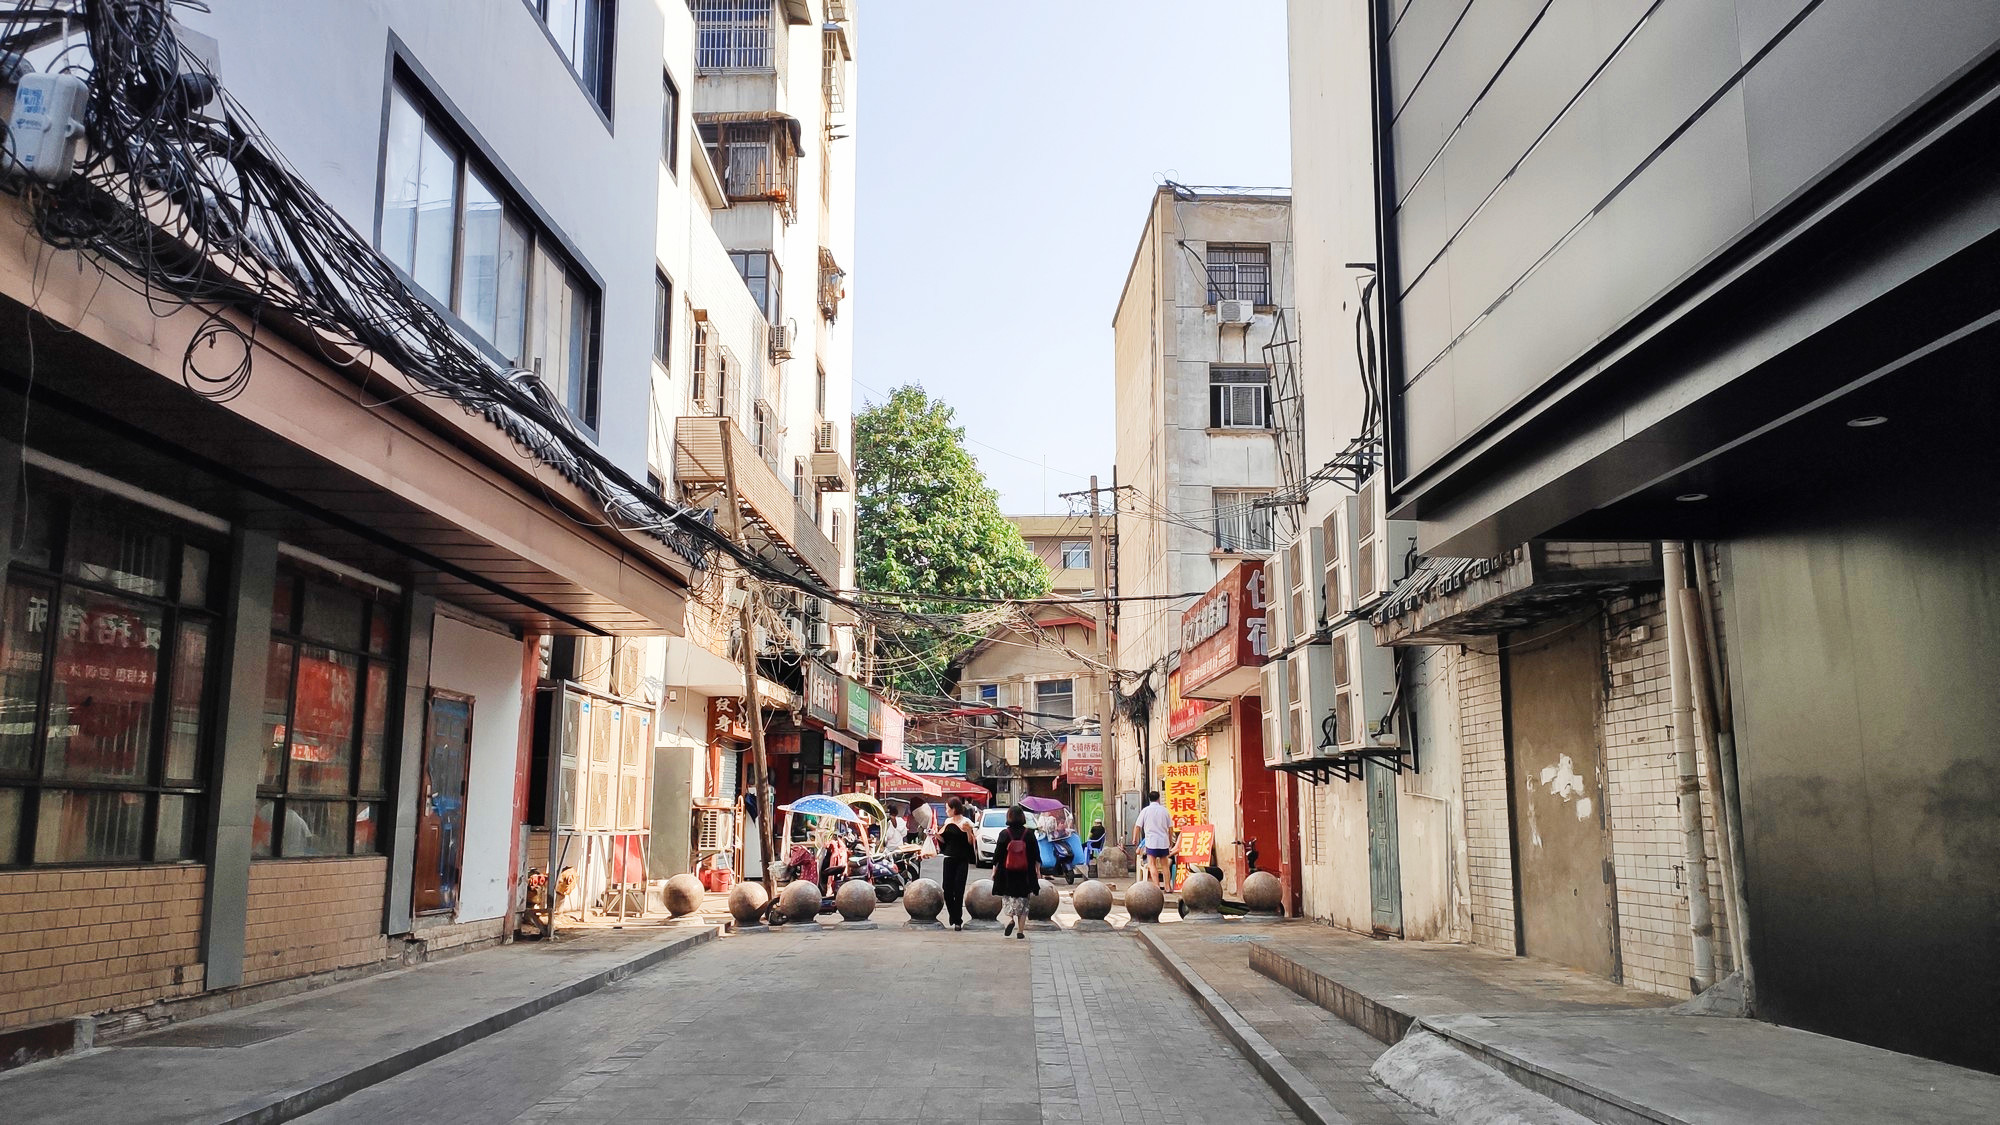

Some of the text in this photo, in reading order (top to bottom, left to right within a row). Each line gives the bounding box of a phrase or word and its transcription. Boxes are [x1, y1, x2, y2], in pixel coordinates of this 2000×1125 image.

[715, 697, 733, 732] 纹身
[1020, 741, 1054, 760] 好缘来
[1170, 781, 1198, 828] 杂粮饼
[1179, 830, 1212, 857] 豆浆
